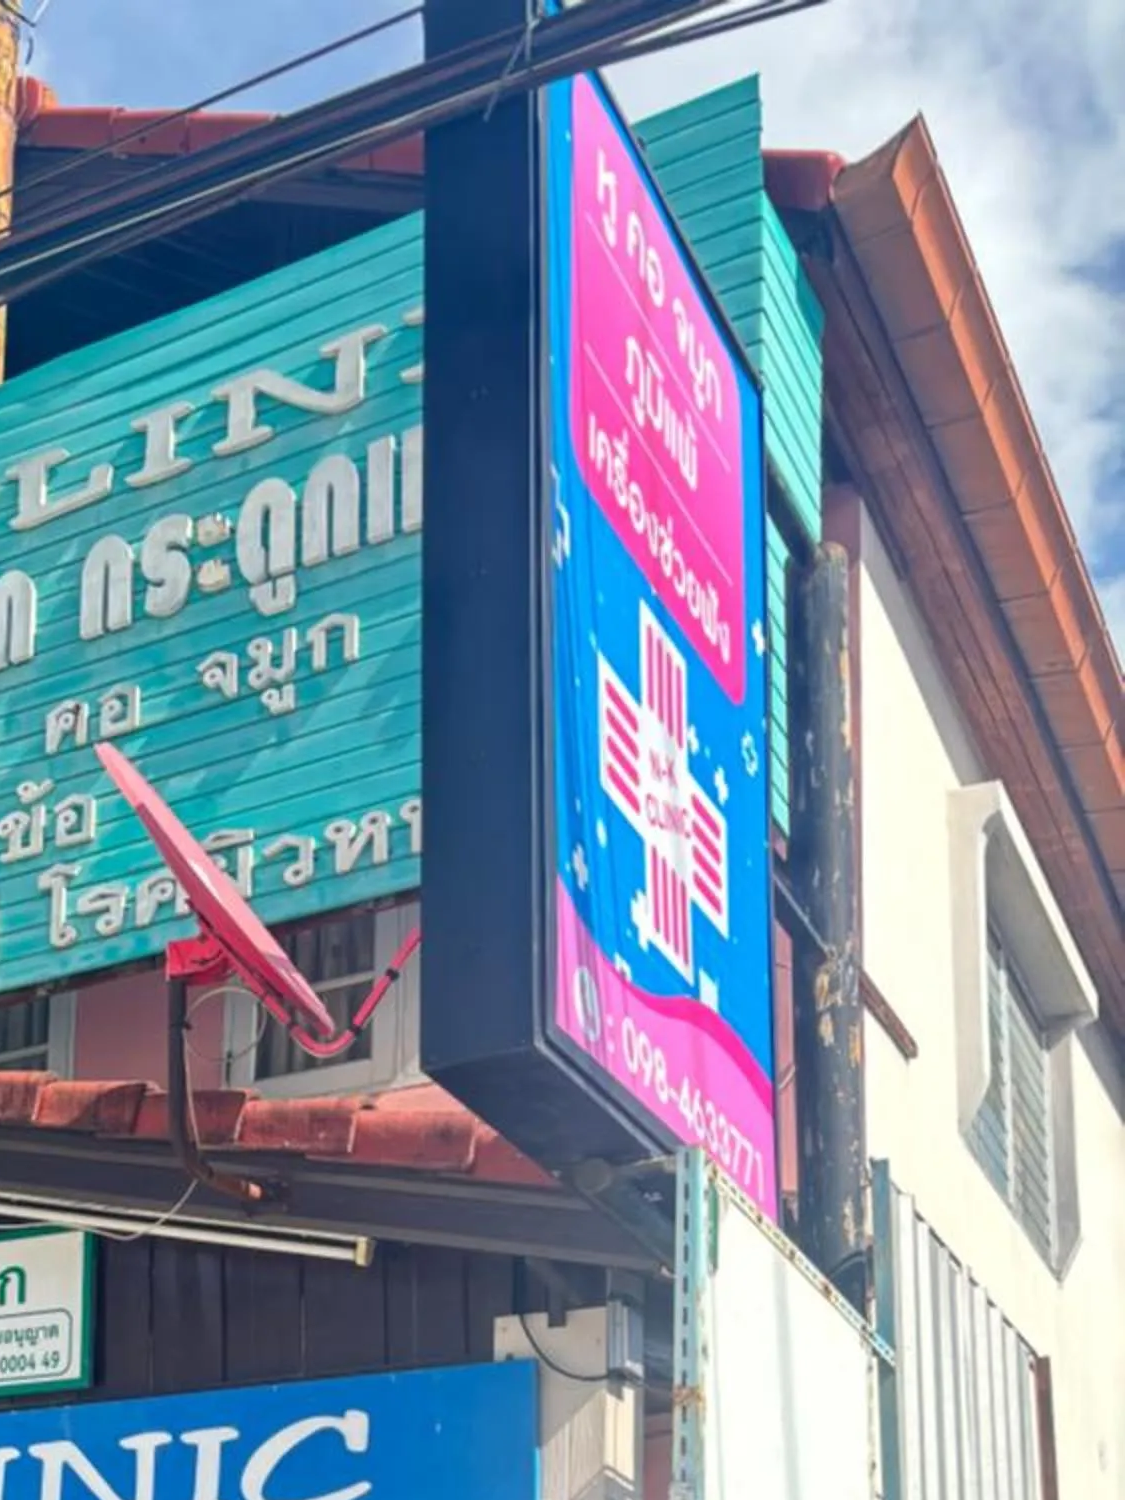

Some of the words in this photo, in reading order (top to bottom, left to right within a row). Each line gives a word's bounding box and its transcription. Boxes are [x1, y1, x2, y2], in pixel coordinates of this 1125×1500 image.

[597, 148, 617, 248] หู
[627, 211, 665, 309] คอ
[672, 297, 723, 420] จมูก
[626, 336, 697, 491] ภูมิแพ้
[46, 684, 141, 754] คอ
[197, 612, 361, 716] จมูก
[645, 793, 691, 840] CLINIC
[621, 1015, 765, 1203] 098-4633771
[0, 1353, 36, 1373] 0004
